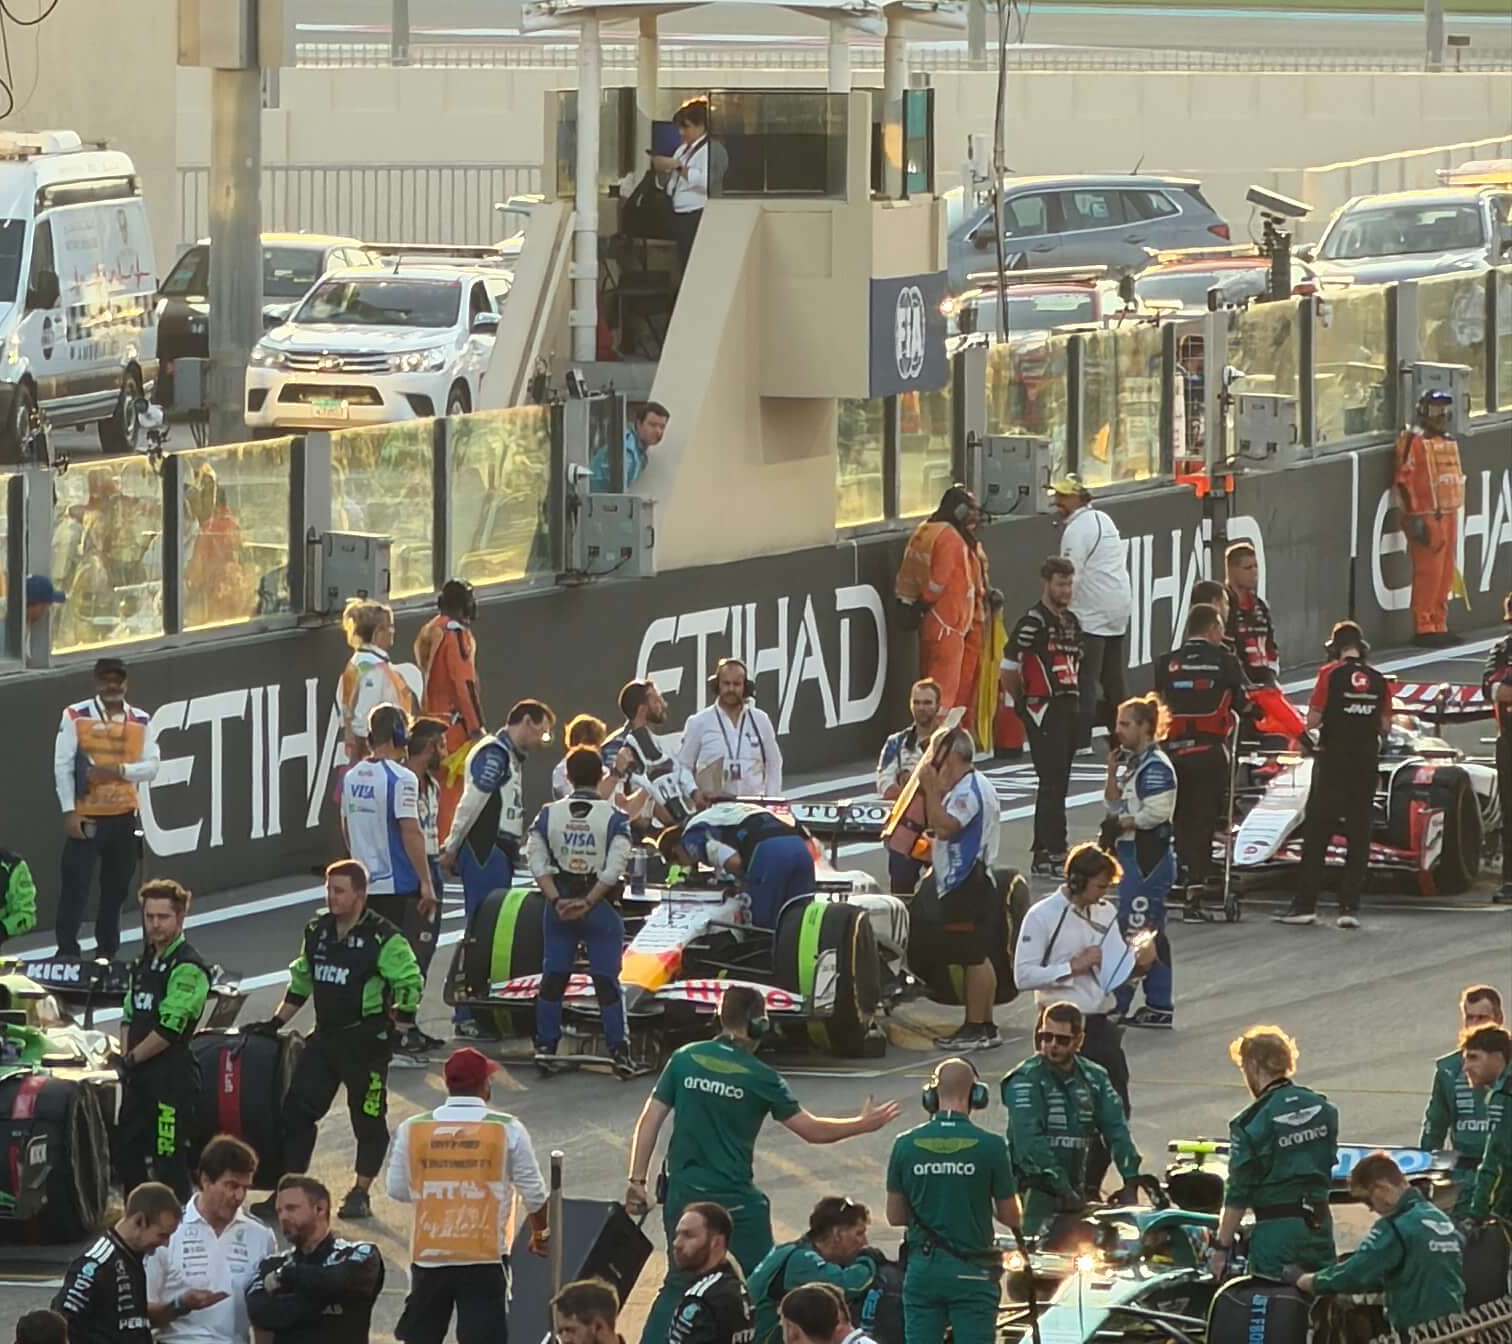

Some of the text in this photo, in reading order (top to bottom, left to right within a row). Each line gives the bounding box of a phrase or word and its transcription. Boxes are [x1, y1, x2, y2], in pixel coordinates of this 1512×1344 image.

[635, 583, 888, 755] ETIHAD
[562, 832, 596, 848] VISA
[26, 963, 81, 981] KICK
[314, 964, 351, 984] KICK
[683, 1076, 746, 1101] aramco
[914, 1161, 976, 1176] aramco
